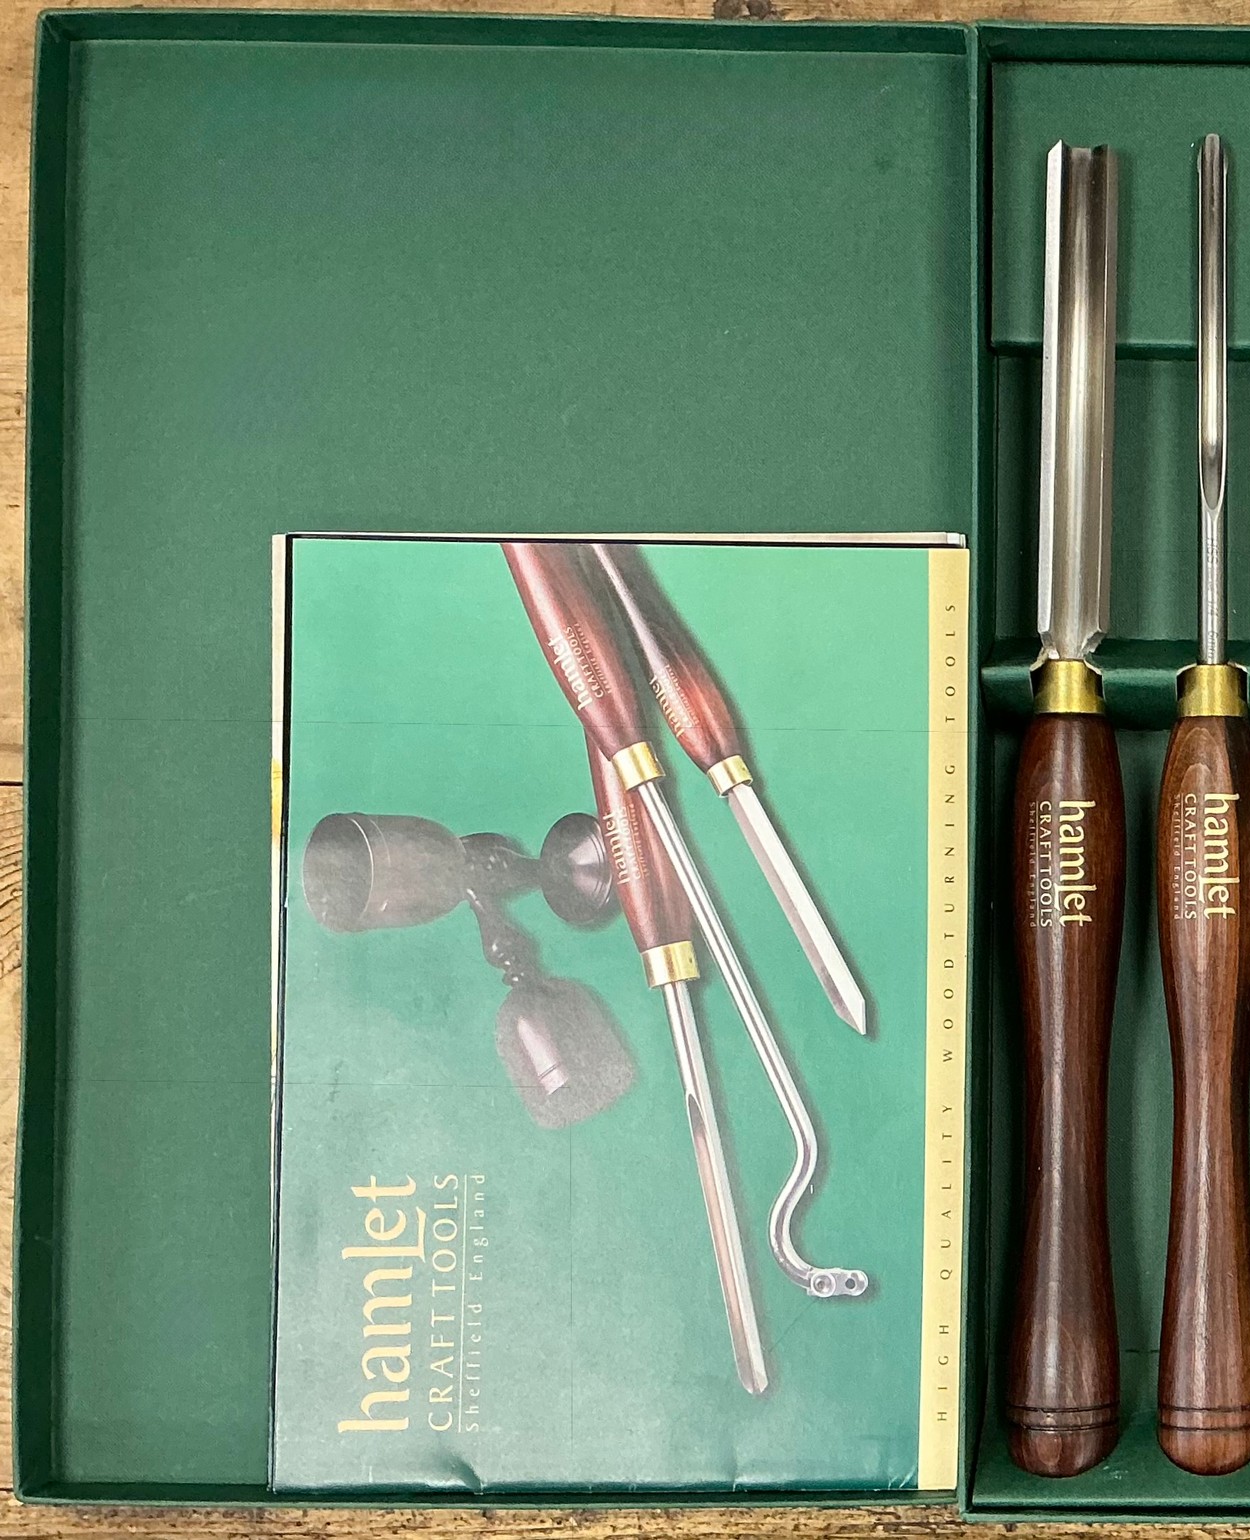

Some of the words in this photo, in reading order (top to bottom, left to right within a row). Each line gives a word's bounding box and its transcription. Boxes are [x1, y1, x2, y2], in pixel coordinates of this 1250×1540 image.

[548, 637, 593, 711] hamlet
[566, 626, 584, 662] TOOLS
[582, 663, 604, 698] CRAFT
[945, 605, 956, 723] TOOLS
[1040, 801, 1052, 860] CRAFT
[1054, 800, 1097, 927] hamlet
[1184, 793, 1196, 853] CRAFT
[1198, 792, 1240, 920] hamlet
[942, 765, 955, 1062] WOODTURNING
[1040, 866, 1052, 928] TOOLS
[1184, 859, 1196, 920] TOOLS
[432, 1174, 458, 1298] TOOLS
[469, 1174, 489, 1282] England
[940, 1105, 952, 1280] QUALITY
[337, 1173, 428, 1434] hamlet
[428, 1308, 455, 1432] CRAFT
[465, 1302, 482, 1432] Sheffield
[937, 1325, 950, 1421] HIGH
